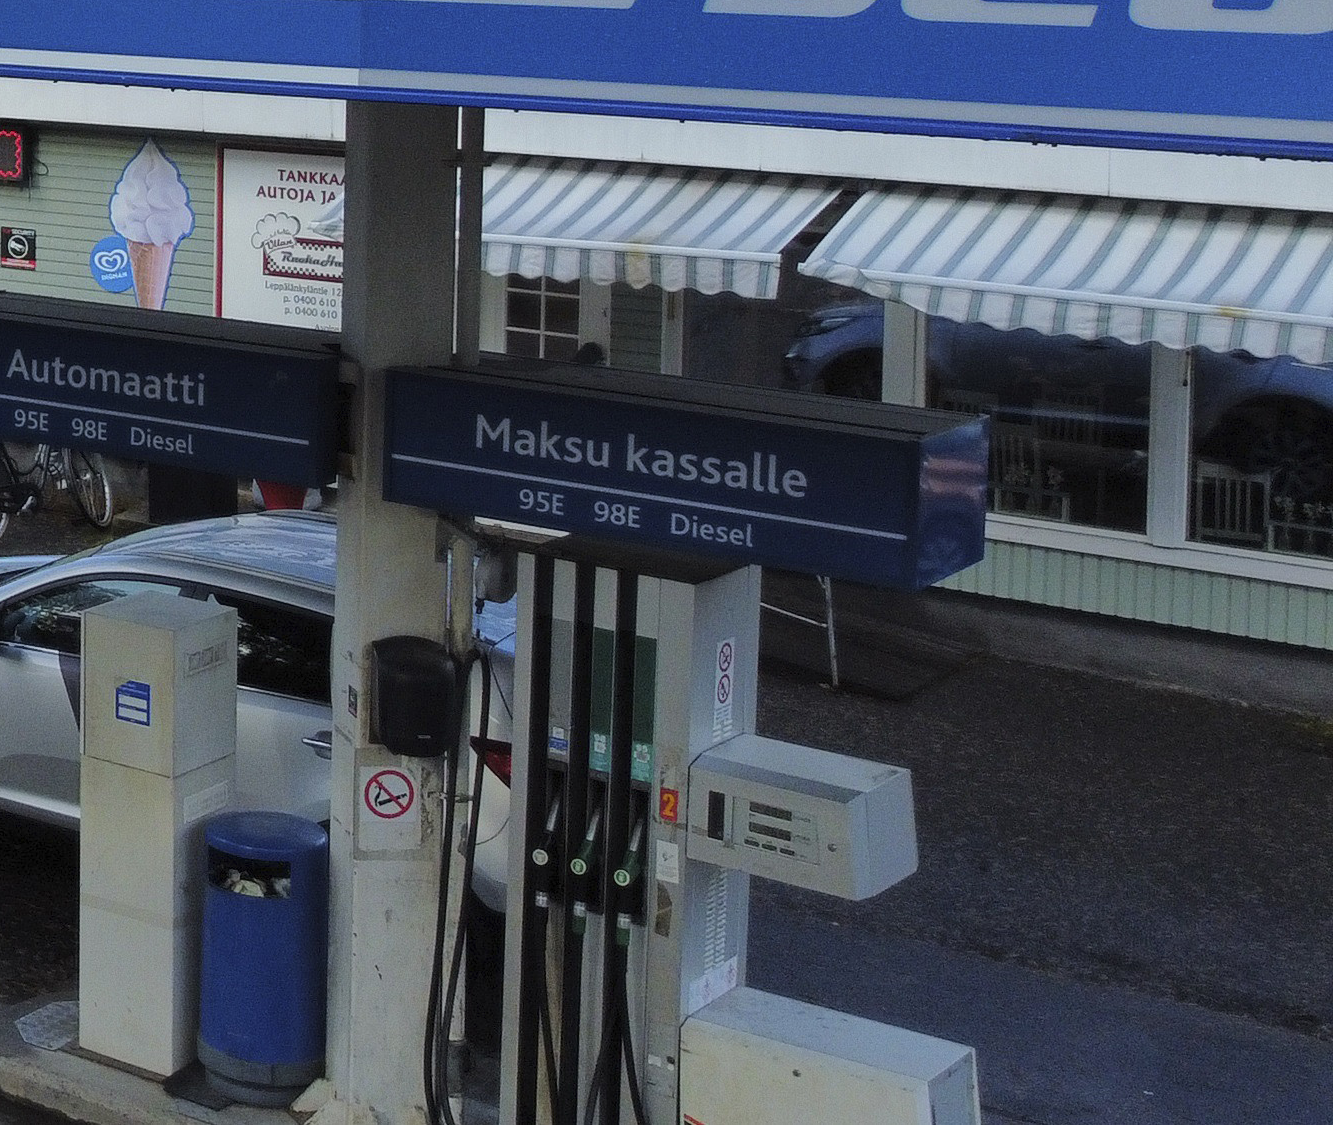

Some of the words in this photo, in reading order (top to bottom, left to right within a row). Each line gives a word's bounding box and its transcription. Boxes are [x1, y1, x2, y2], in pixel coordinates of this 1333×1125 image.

[256, 186, 316, 203] AUTOJA
[293, 295, 316, 305] 0400
[319, 298, 337, 307] 610
[295, 306, 318, 317] 0400
[320, 309, 338, 319] 610
[5, 348, 205, 406] Automaatti
[14, 408, 50, 433] 95E
[71, 417, 108, 442] 98E
[130, 426, 194, 455] Diesel
[475, 413, 610, 469] Maksu
[626, 433, 808, 498] kassalle
[519, 488, 564, 516] 95E
[593, 501, 641, 528] 98E
[669, 512, 754, 548] Diesel
[661, 792, 676, 817] 2
